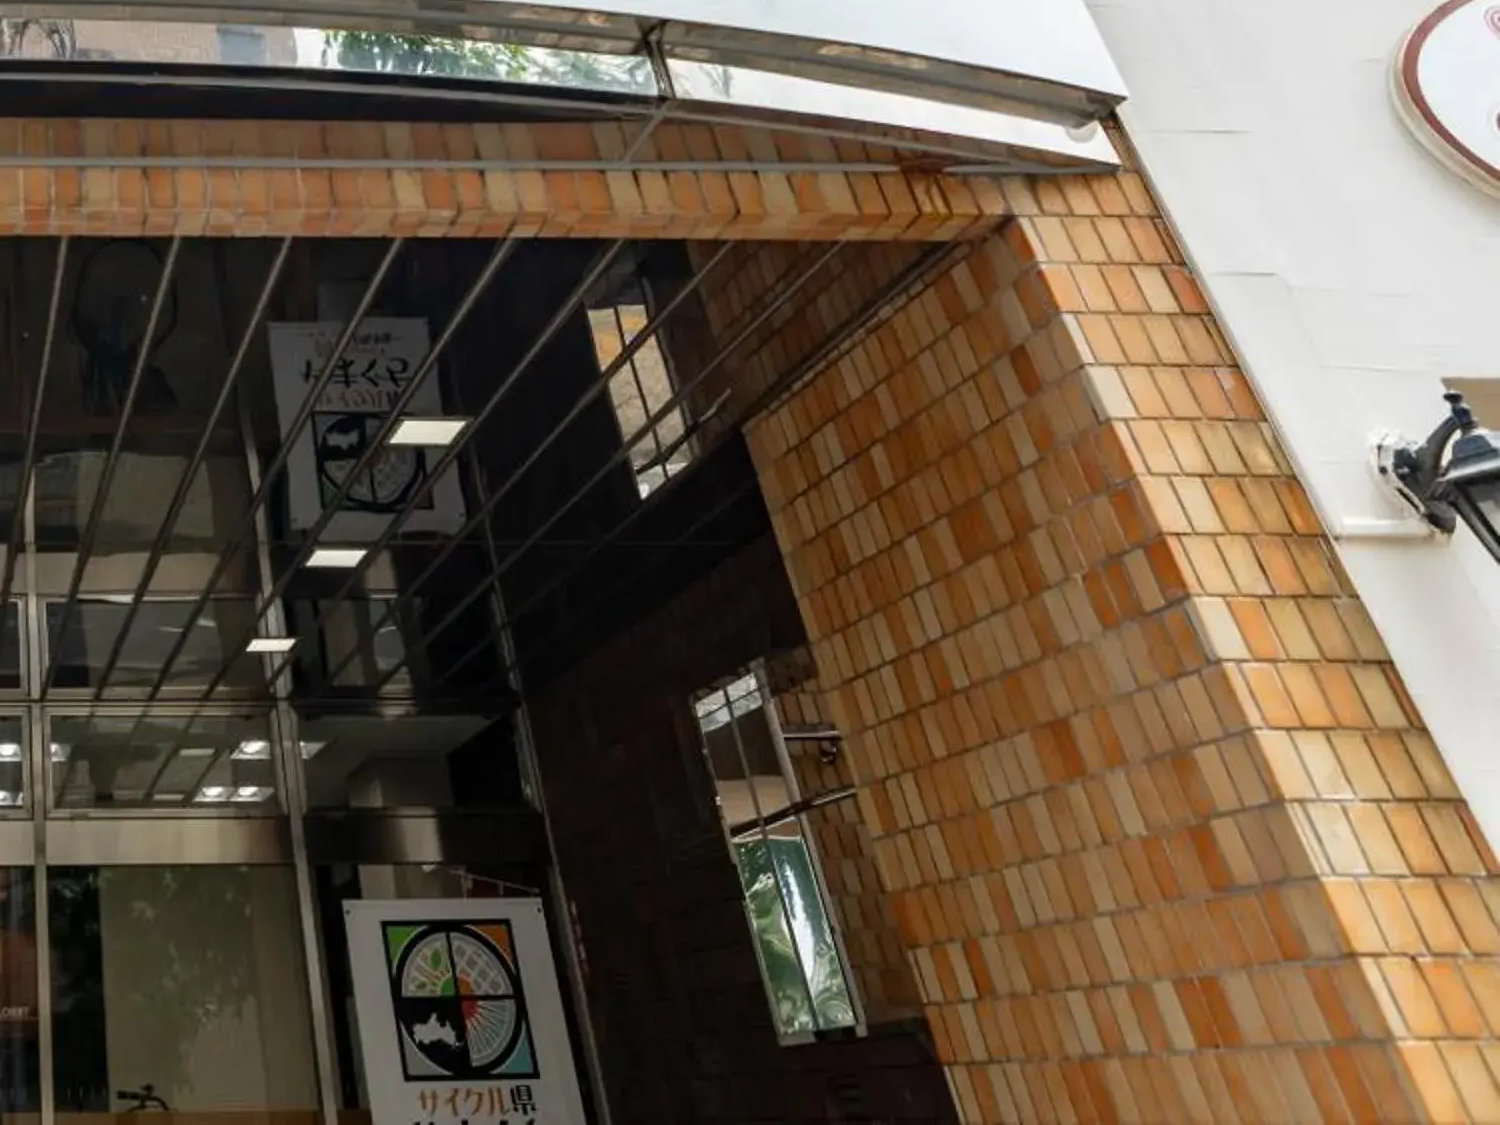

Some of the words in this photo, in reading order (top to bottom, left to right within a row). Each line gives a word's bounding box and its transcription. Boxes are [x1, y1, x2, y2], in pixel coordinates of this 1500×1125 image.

[416, 1084, 538, 1116] サイクル県
